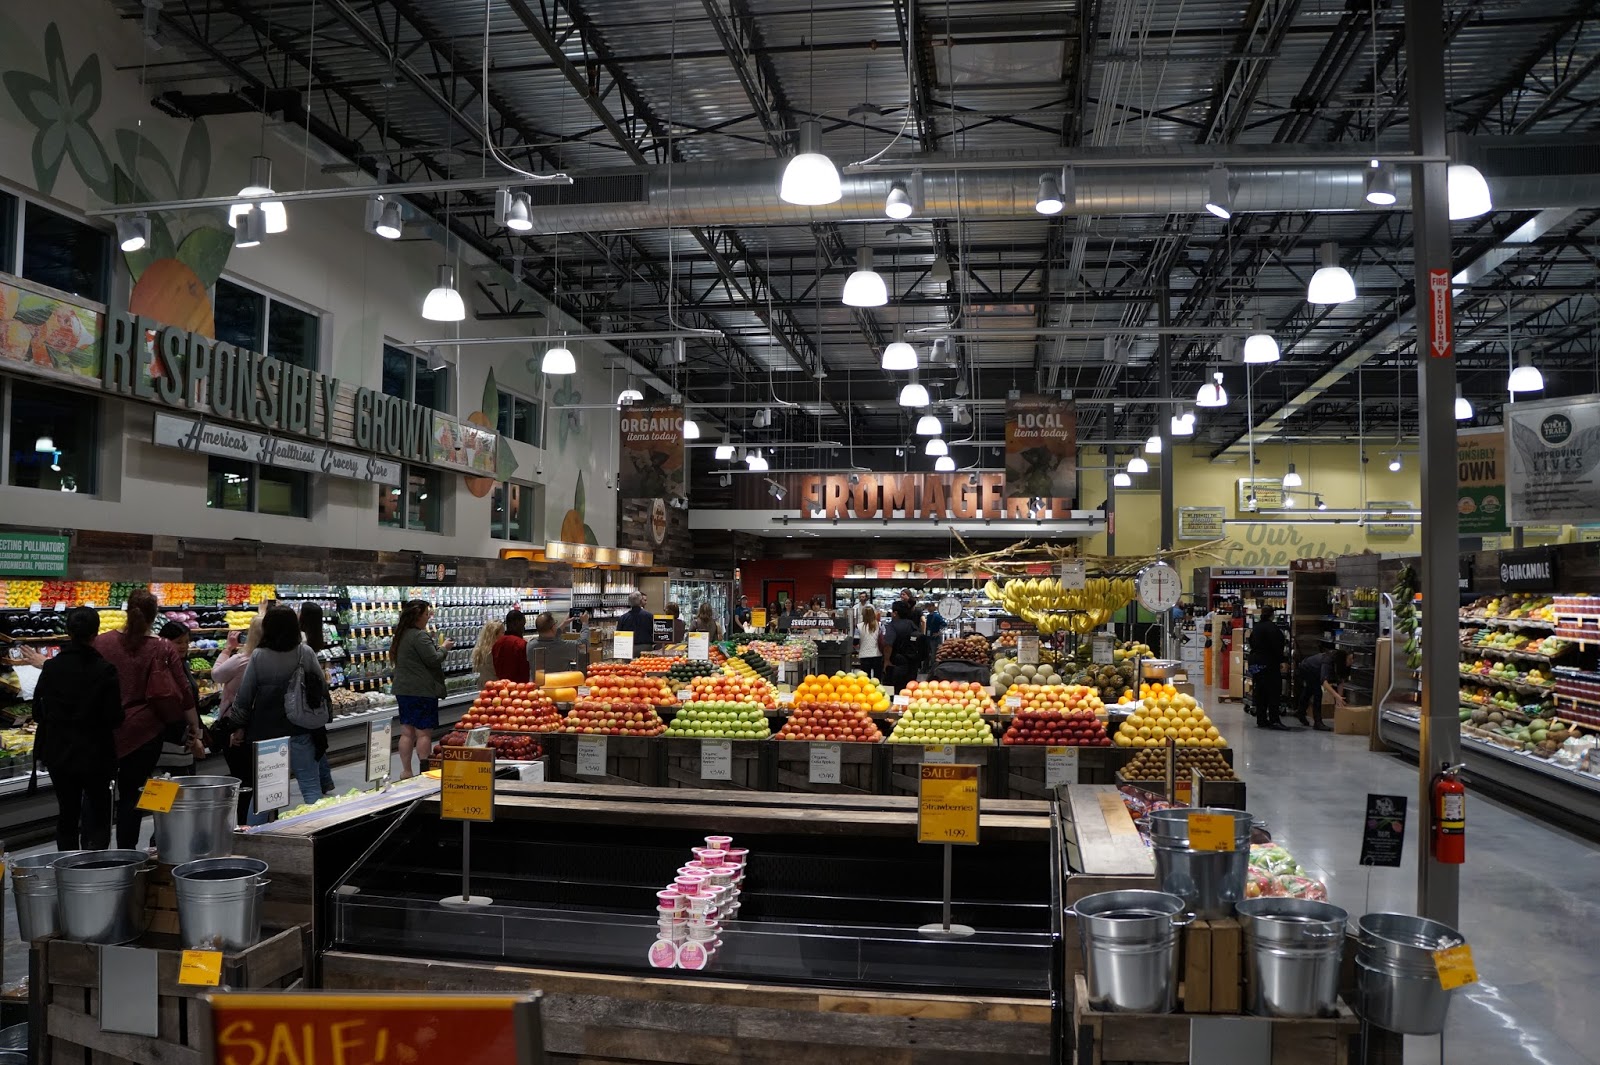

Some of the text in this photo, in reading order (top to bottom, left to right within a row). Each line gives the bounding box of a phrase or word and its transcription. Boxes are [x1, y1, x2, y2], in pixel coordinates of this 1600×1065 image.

[1432, 277, 1447, 286] FIRE
[102, 311, 434, 462] RESPONSIBLY GROWN
[621, 417, 683, 433] ORGANIC
[1017, 413, 1063, 428] LOCAL
[1543, 421, 1567, 429] WHOLE
[627, 432, 677, 443] items today
[1014, 428, 1068, 441] items today
[178, 421, 389, 481] America's Healthiest Grocery Store
[1459, 448, 1496, 461] ONSIBLY
[1533, 448, 1582, 459] IMPROVING
[1533, 457, 1583, 471] LIVES
[1459, 461, 1496, 481] OWN
[1245, 523, 1303, 546] Our
[0, 539, 66, 553] ECTING POLLINATORS
[1225, 541, 1289, 567] Core
[0, 560, 65, 571] VIRONMENTAL PROTECTION
[1508, 562, 1550, 580] GUACAMOLE
[791, 619, 834, 627] SEVERINO PASTA
[444, 749, 473, 760] SALE!
[922, 767, 956, 779] SALE!
[444, 782, 489, 791] Strawberries
[921, 802, 974, 812] Strawberries
